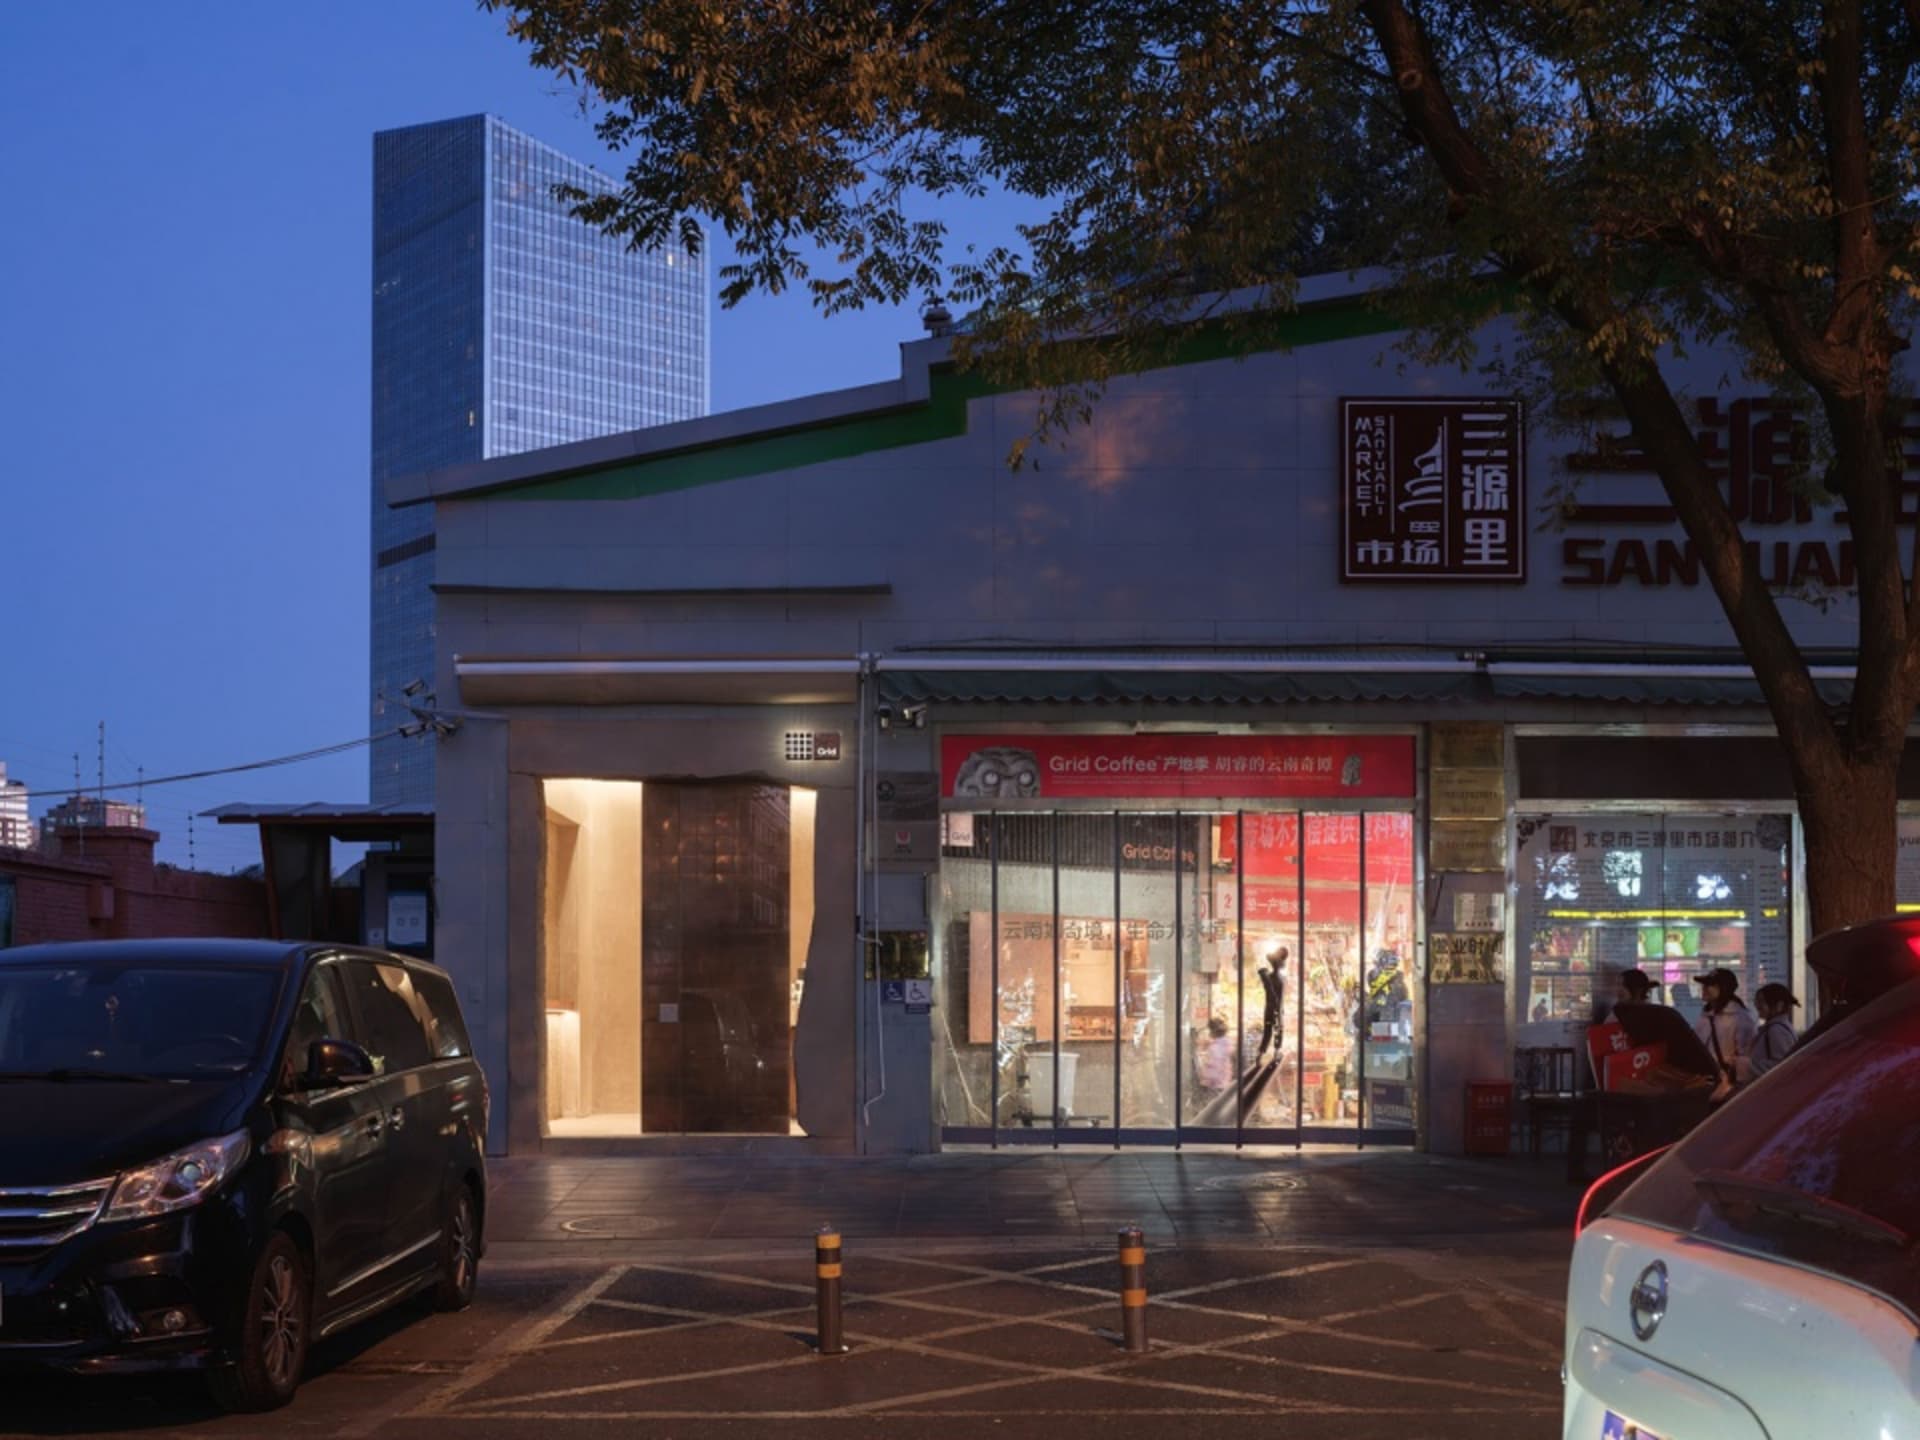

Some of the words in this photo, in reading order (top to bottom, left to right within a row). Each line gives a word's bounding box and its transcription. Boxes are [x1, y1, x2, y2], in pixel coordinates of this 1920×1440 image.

[1355, 416, 1373, 518] MARKET
[1461, 412, 1509, 566] 三源里
[1355, 538, 1440, 566] 市场
[1050, 755, 1089, 772] Grid
[1094, 755, 1157, 772] Coffee
